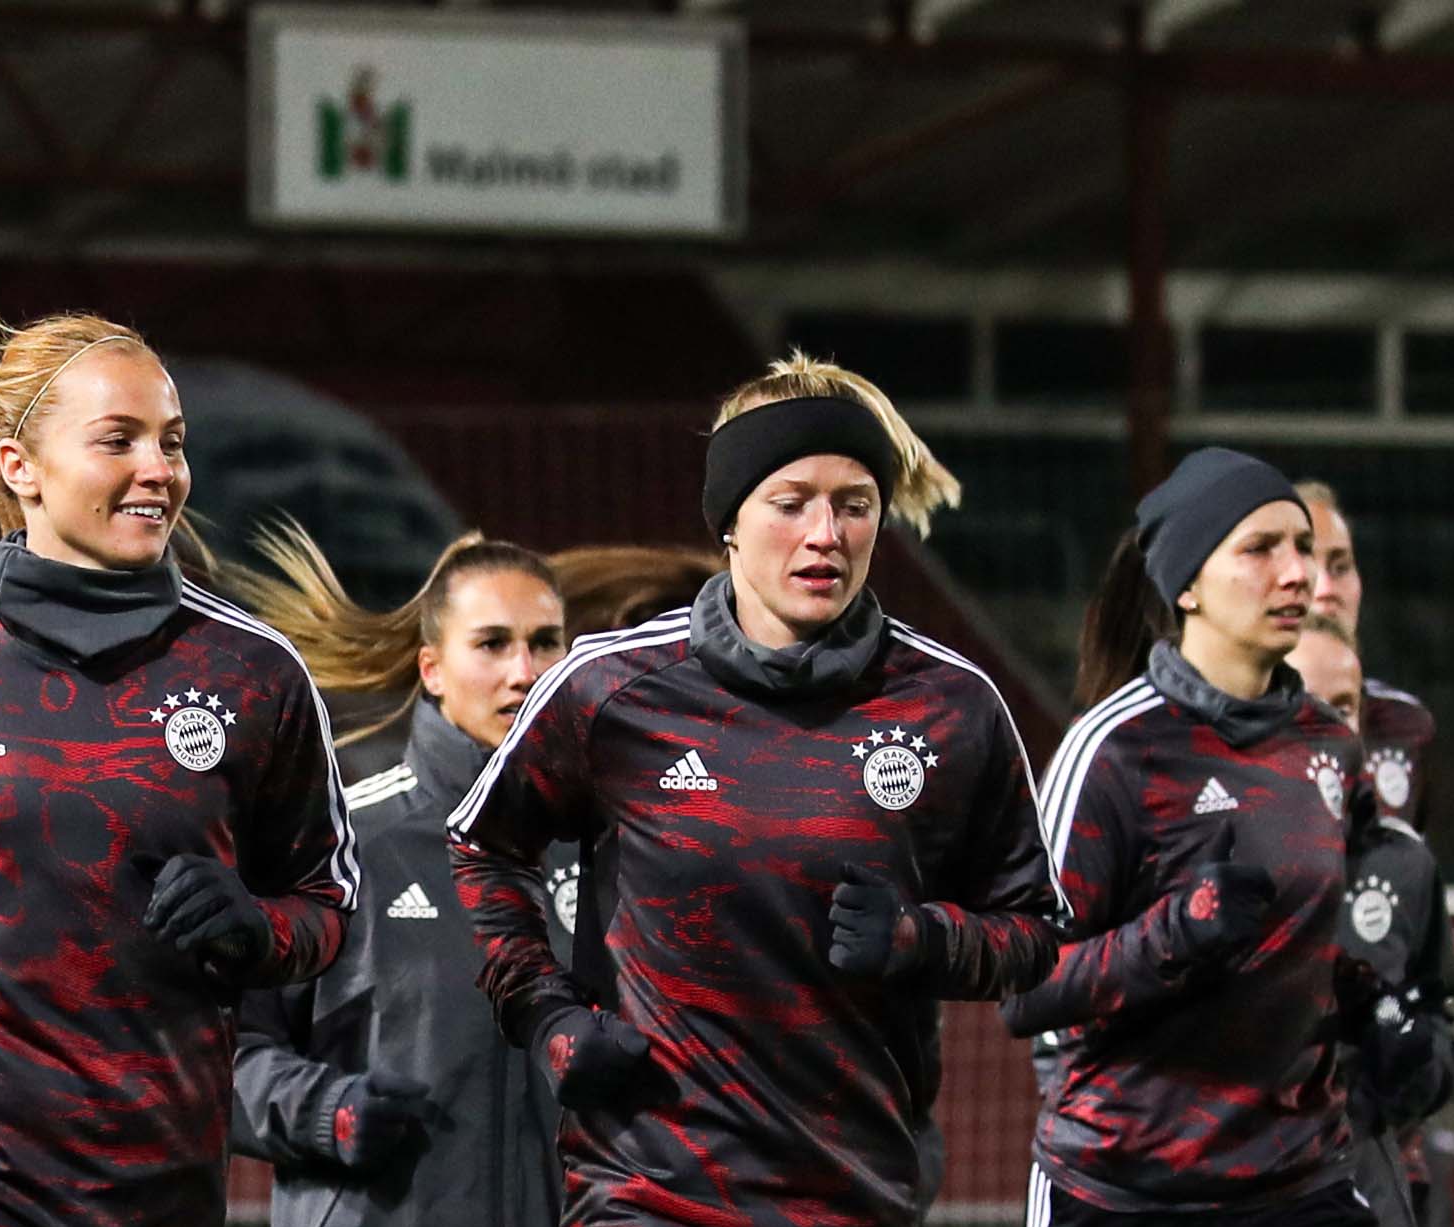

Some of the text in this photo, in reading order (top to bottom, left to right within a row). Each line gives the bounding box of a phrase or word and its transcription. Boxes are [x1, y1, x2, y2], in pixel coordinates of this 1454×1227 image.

[171, 713, 218, 735] FC BAYERN
[871, 751, 918, 776] FC BAYERN
[659, 775, 717, 791] adidas
[387, 905, 438, 918] adidas
